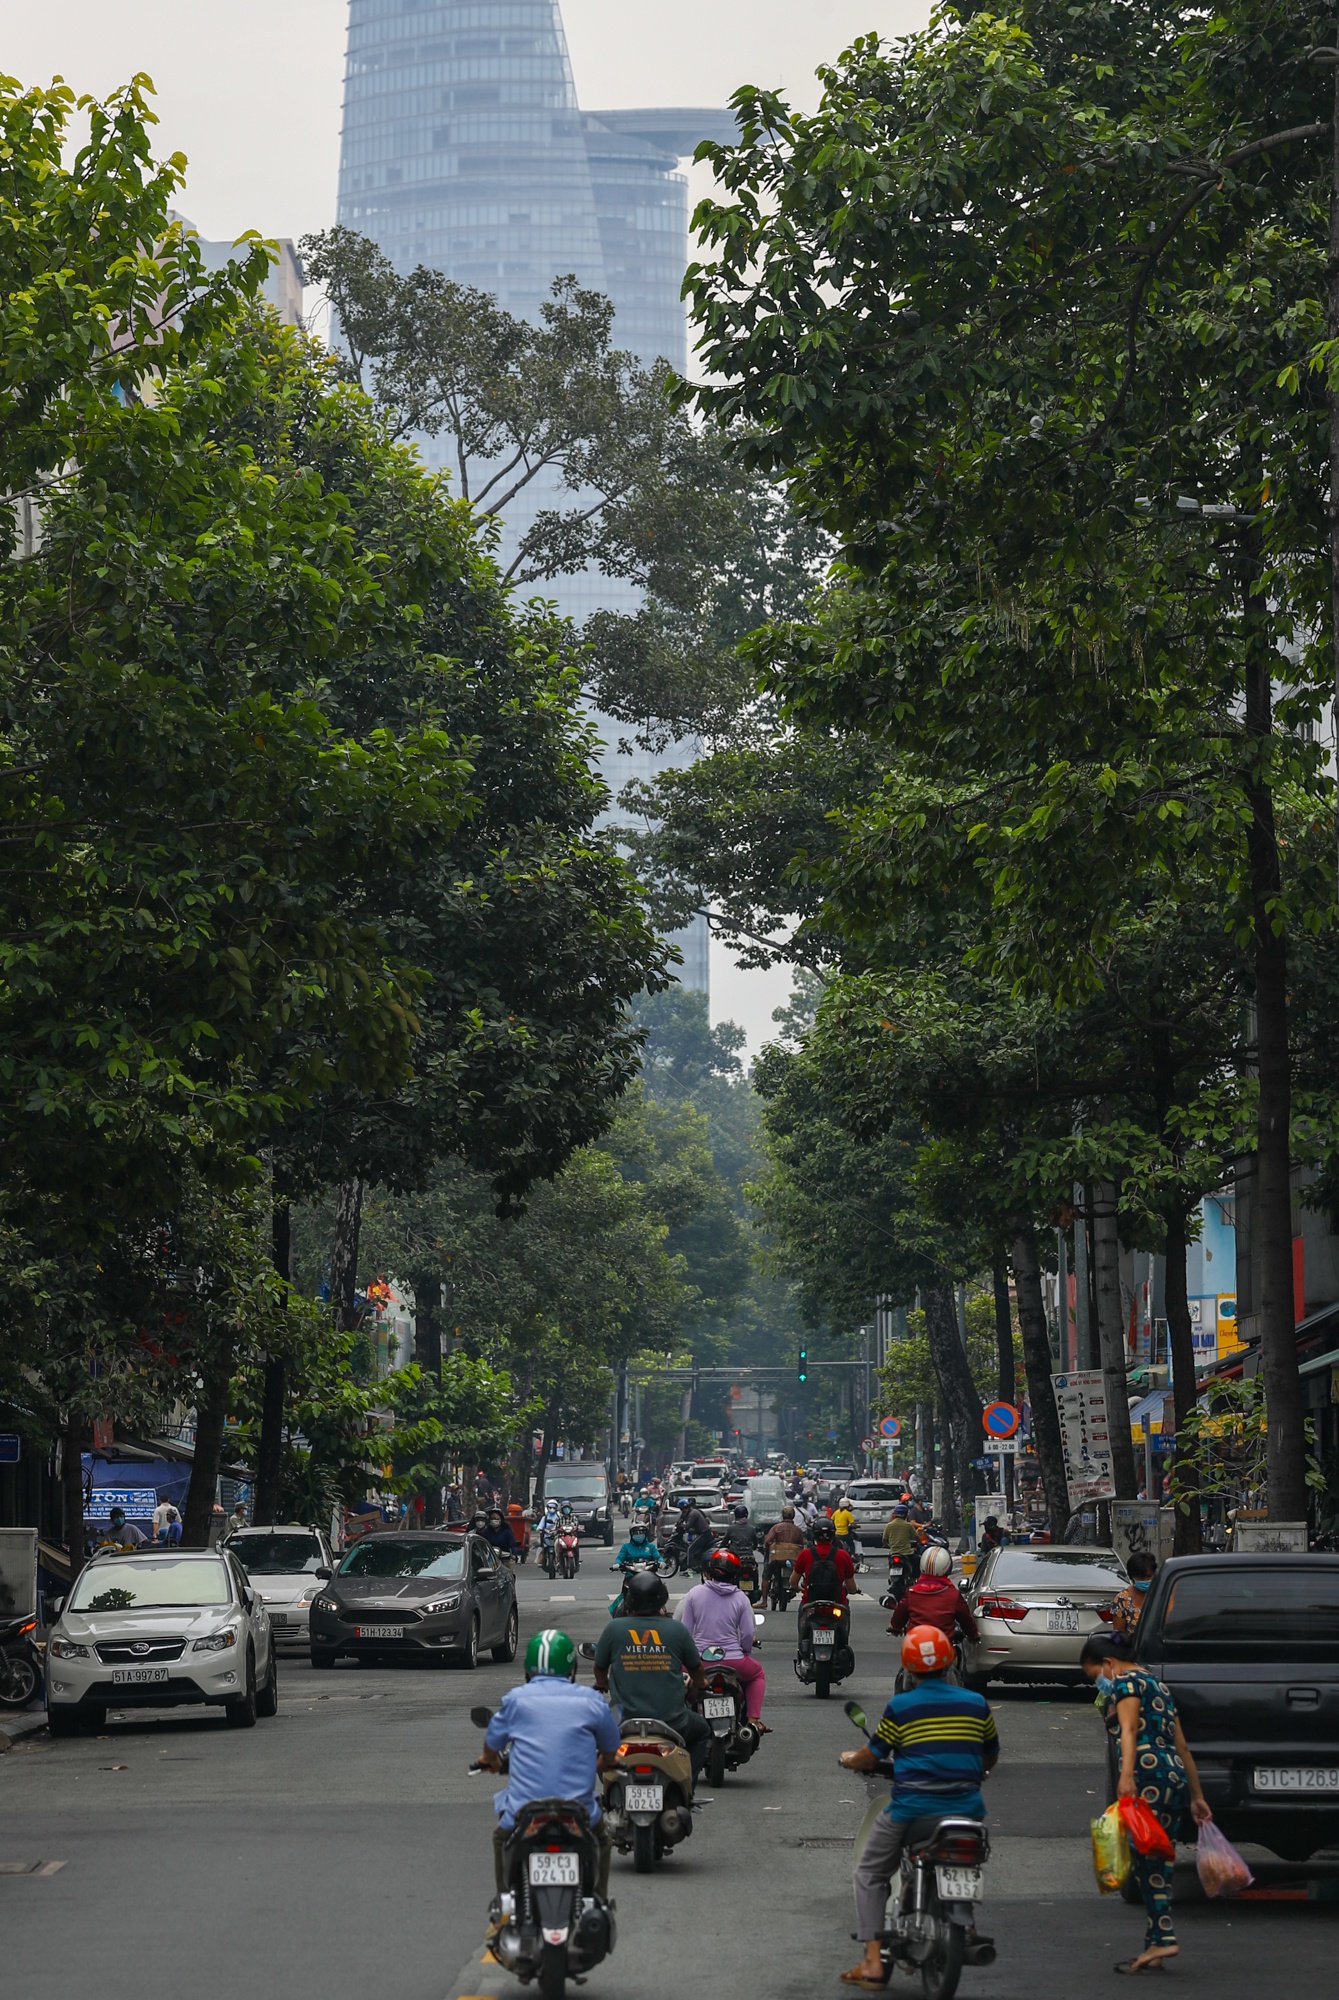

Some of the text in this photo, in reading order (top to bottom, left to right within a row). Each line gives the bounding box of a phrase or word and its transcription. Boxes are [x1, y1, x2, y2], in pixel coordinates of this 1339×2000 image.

[1055, 1611, 1071, 1620] 51A
[1048, 1620, 1077, 1630] 984.52
[115, 1670, 166, 1682] 51A-997.87
[709, 1706, 730, 1716] 4139
[628, 1799, 660, 1809] 402.45
[533, 1869, 575, 1882] 024.10
[947, 1882, 978, 1898] 4352
